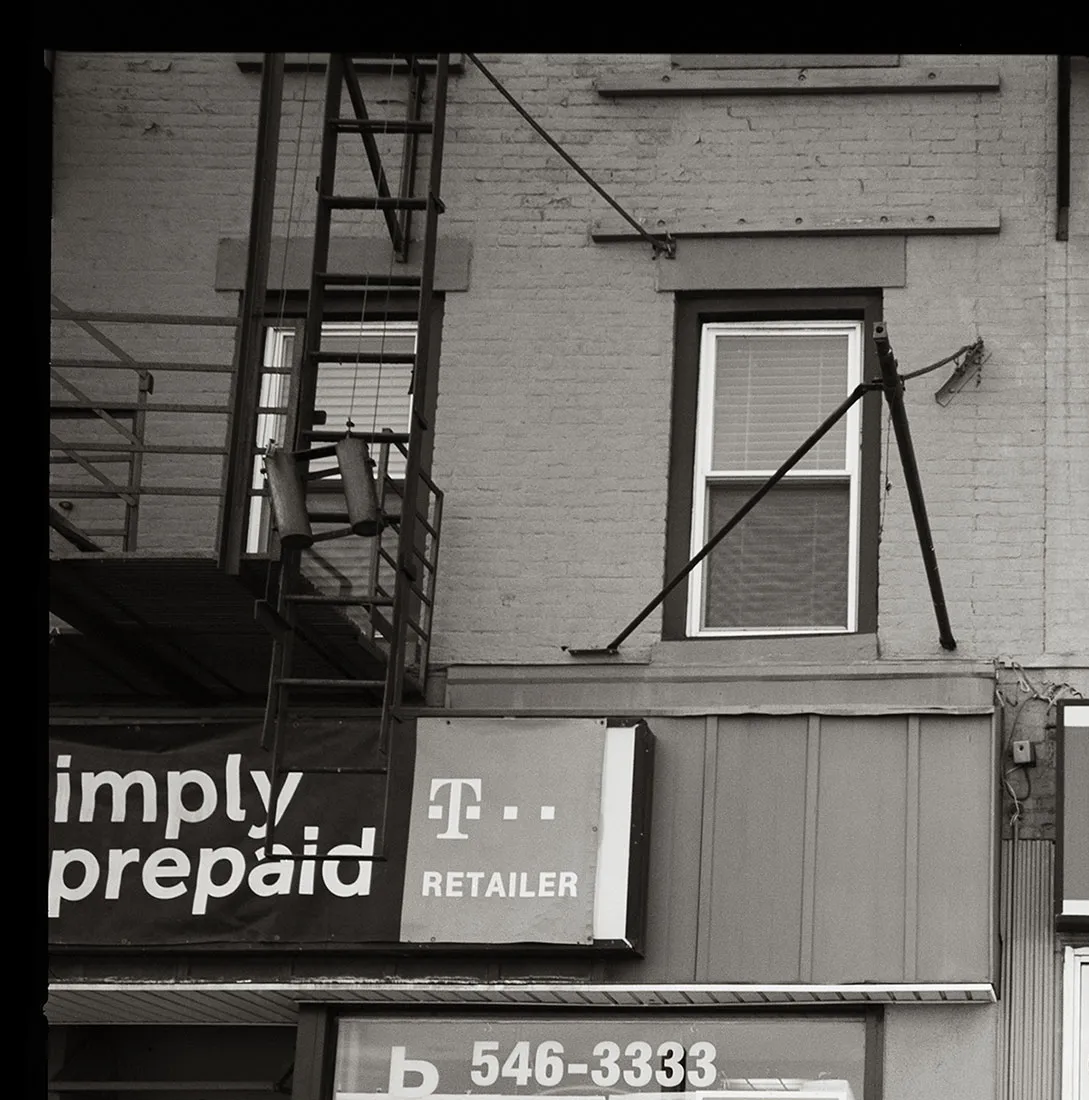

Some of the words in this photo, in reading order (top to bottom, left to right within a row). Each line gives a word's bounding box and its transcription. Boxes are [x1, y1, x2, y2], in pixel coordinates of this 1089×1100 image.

[54, 752, 303, 840] imply
[48, 826, 376, 918] prepaid
[421, 870, 578, 898] RETAILER
[470, 1041, 718, 1089] 546-3333
